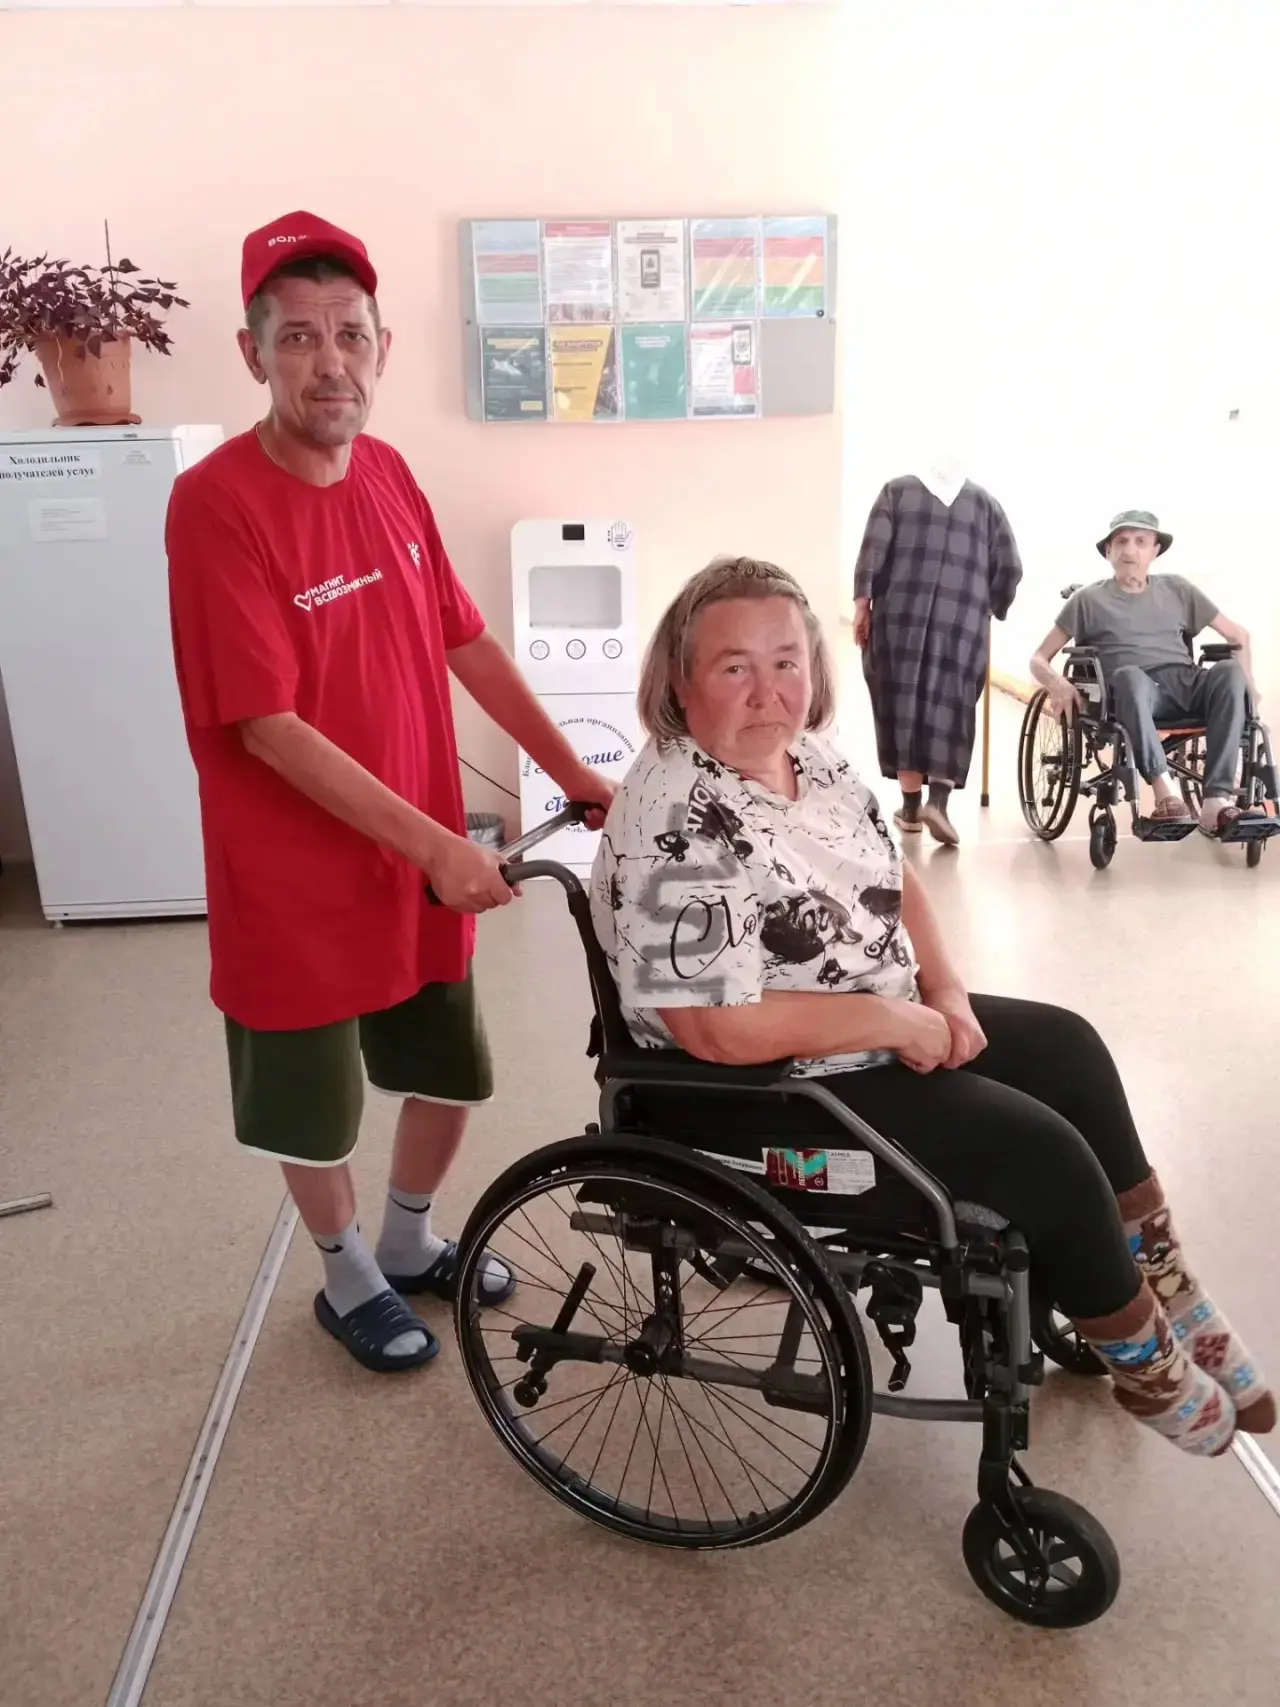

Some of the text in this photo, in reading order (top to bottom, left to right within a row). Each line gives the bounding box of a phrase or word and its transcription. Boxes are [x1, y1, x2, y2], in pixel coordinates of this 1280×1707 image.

[9, 455, 81, 466] Холодильник
[66, 467, 95, 479] услуг
[310, 574, 345, 597] МАГНИТ
[313, 568, 384, 607] ВСЕВОЗМЖНЫЙ
